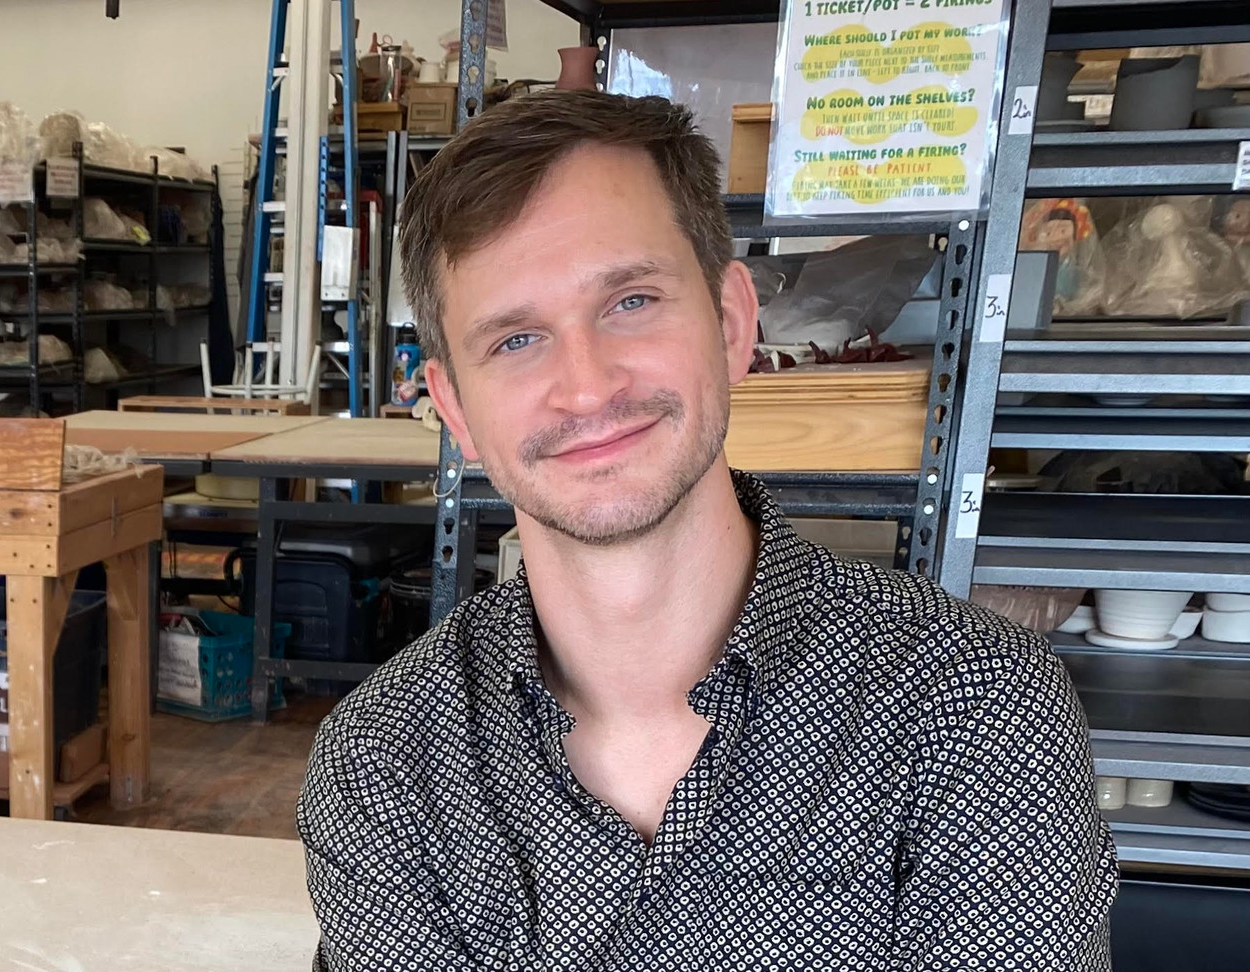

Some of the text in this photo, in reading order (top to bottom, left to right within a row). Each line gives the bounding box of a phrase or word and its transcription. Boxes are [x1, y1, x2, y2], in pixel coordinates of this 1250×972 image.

[805, 1, 811, 16] 1
[816, 0, 899, 15] TICKET/POT
[804, 34, 842, 46] WHERE
[845, 32, 887, 44] SHOULD
[890, 30, 897, 41] I
[900, 30, 921, 41] PUT
[924, 28, 940, 39] MY
[806, 88, 976, 110] NO ROOM ON THE SHELVES?
[816, 125, 826, 137] DO
[828, 125, 844, 136] NOT
[794, 143, 967, 163] STILL WAITING FOR A FIRING?
[828, 162, 931, 176] PLEASE BE PATIENT
